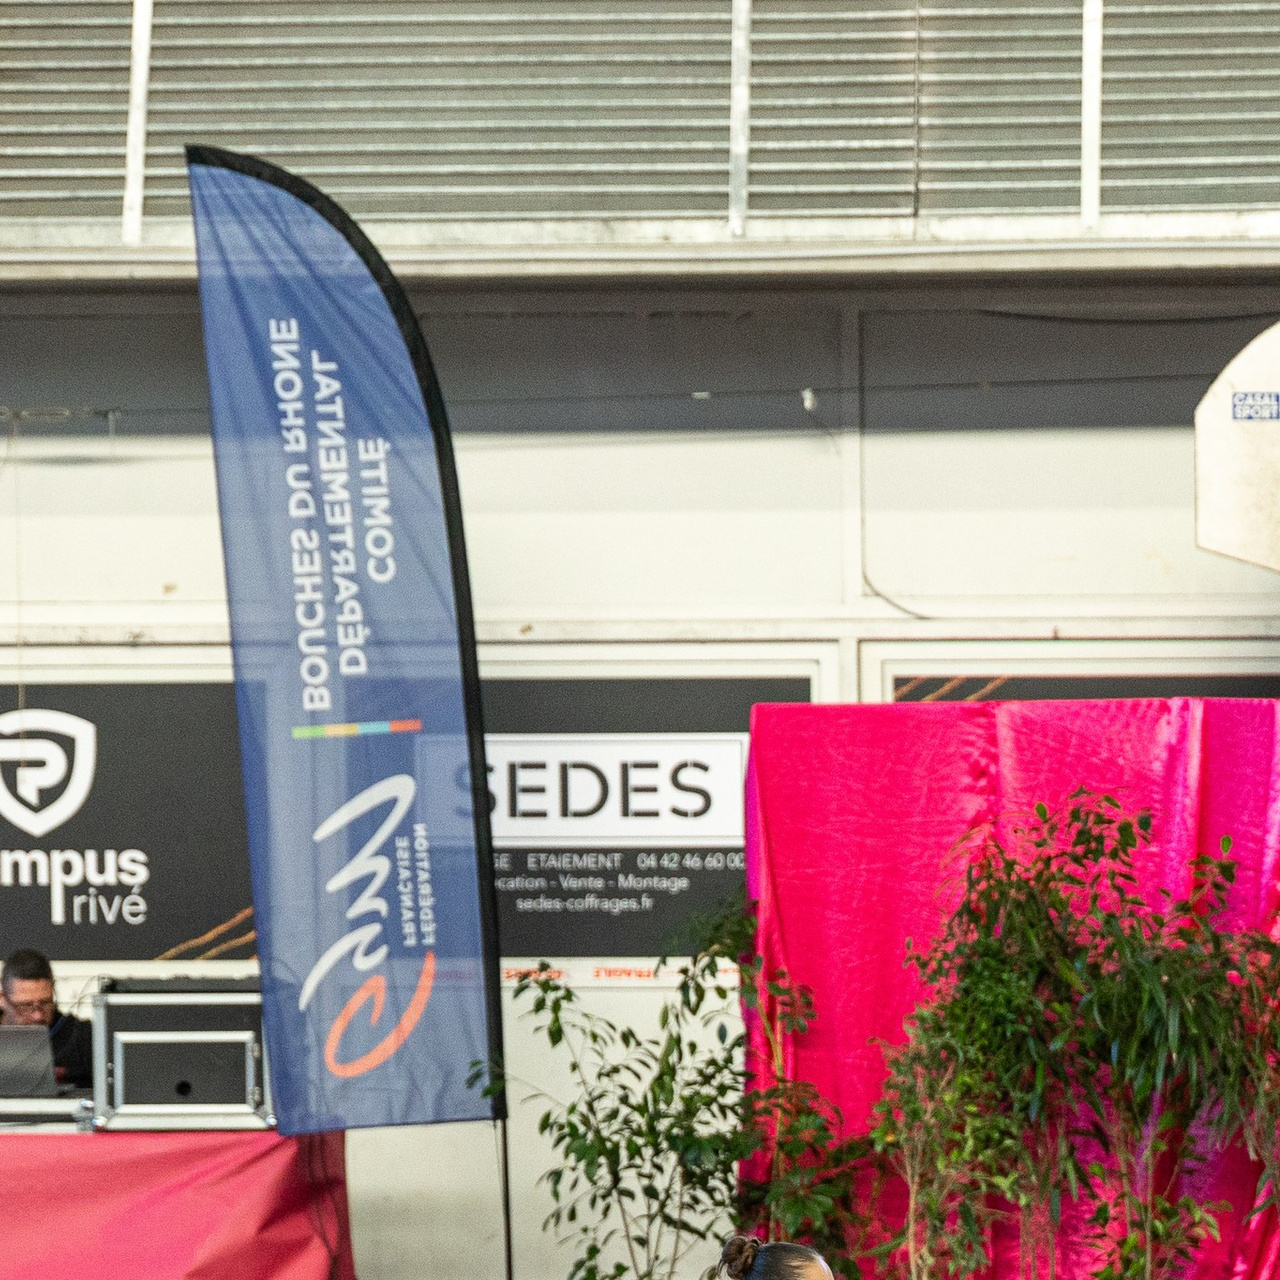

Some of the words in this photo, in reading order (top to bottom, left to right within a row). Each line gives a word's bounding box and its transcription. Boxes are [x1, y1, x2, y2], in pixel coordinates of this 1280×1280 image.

[1234, 404, 1279, 419] SPORT
[455, 760, 713, 818] SEDES
[527, 853, 621, 870] ETAIEMENT
[637, 853, 658, 870] 04
[660, 853, 680, 870] 42
[682, 853, 704, 870] 46
[705, 853, 726, 870] 60
[559, 873, 605, 891] Vente
[618, 873, 690, 894] Montage
[516, 893, 653, 915] sedes-coffrages.fr
